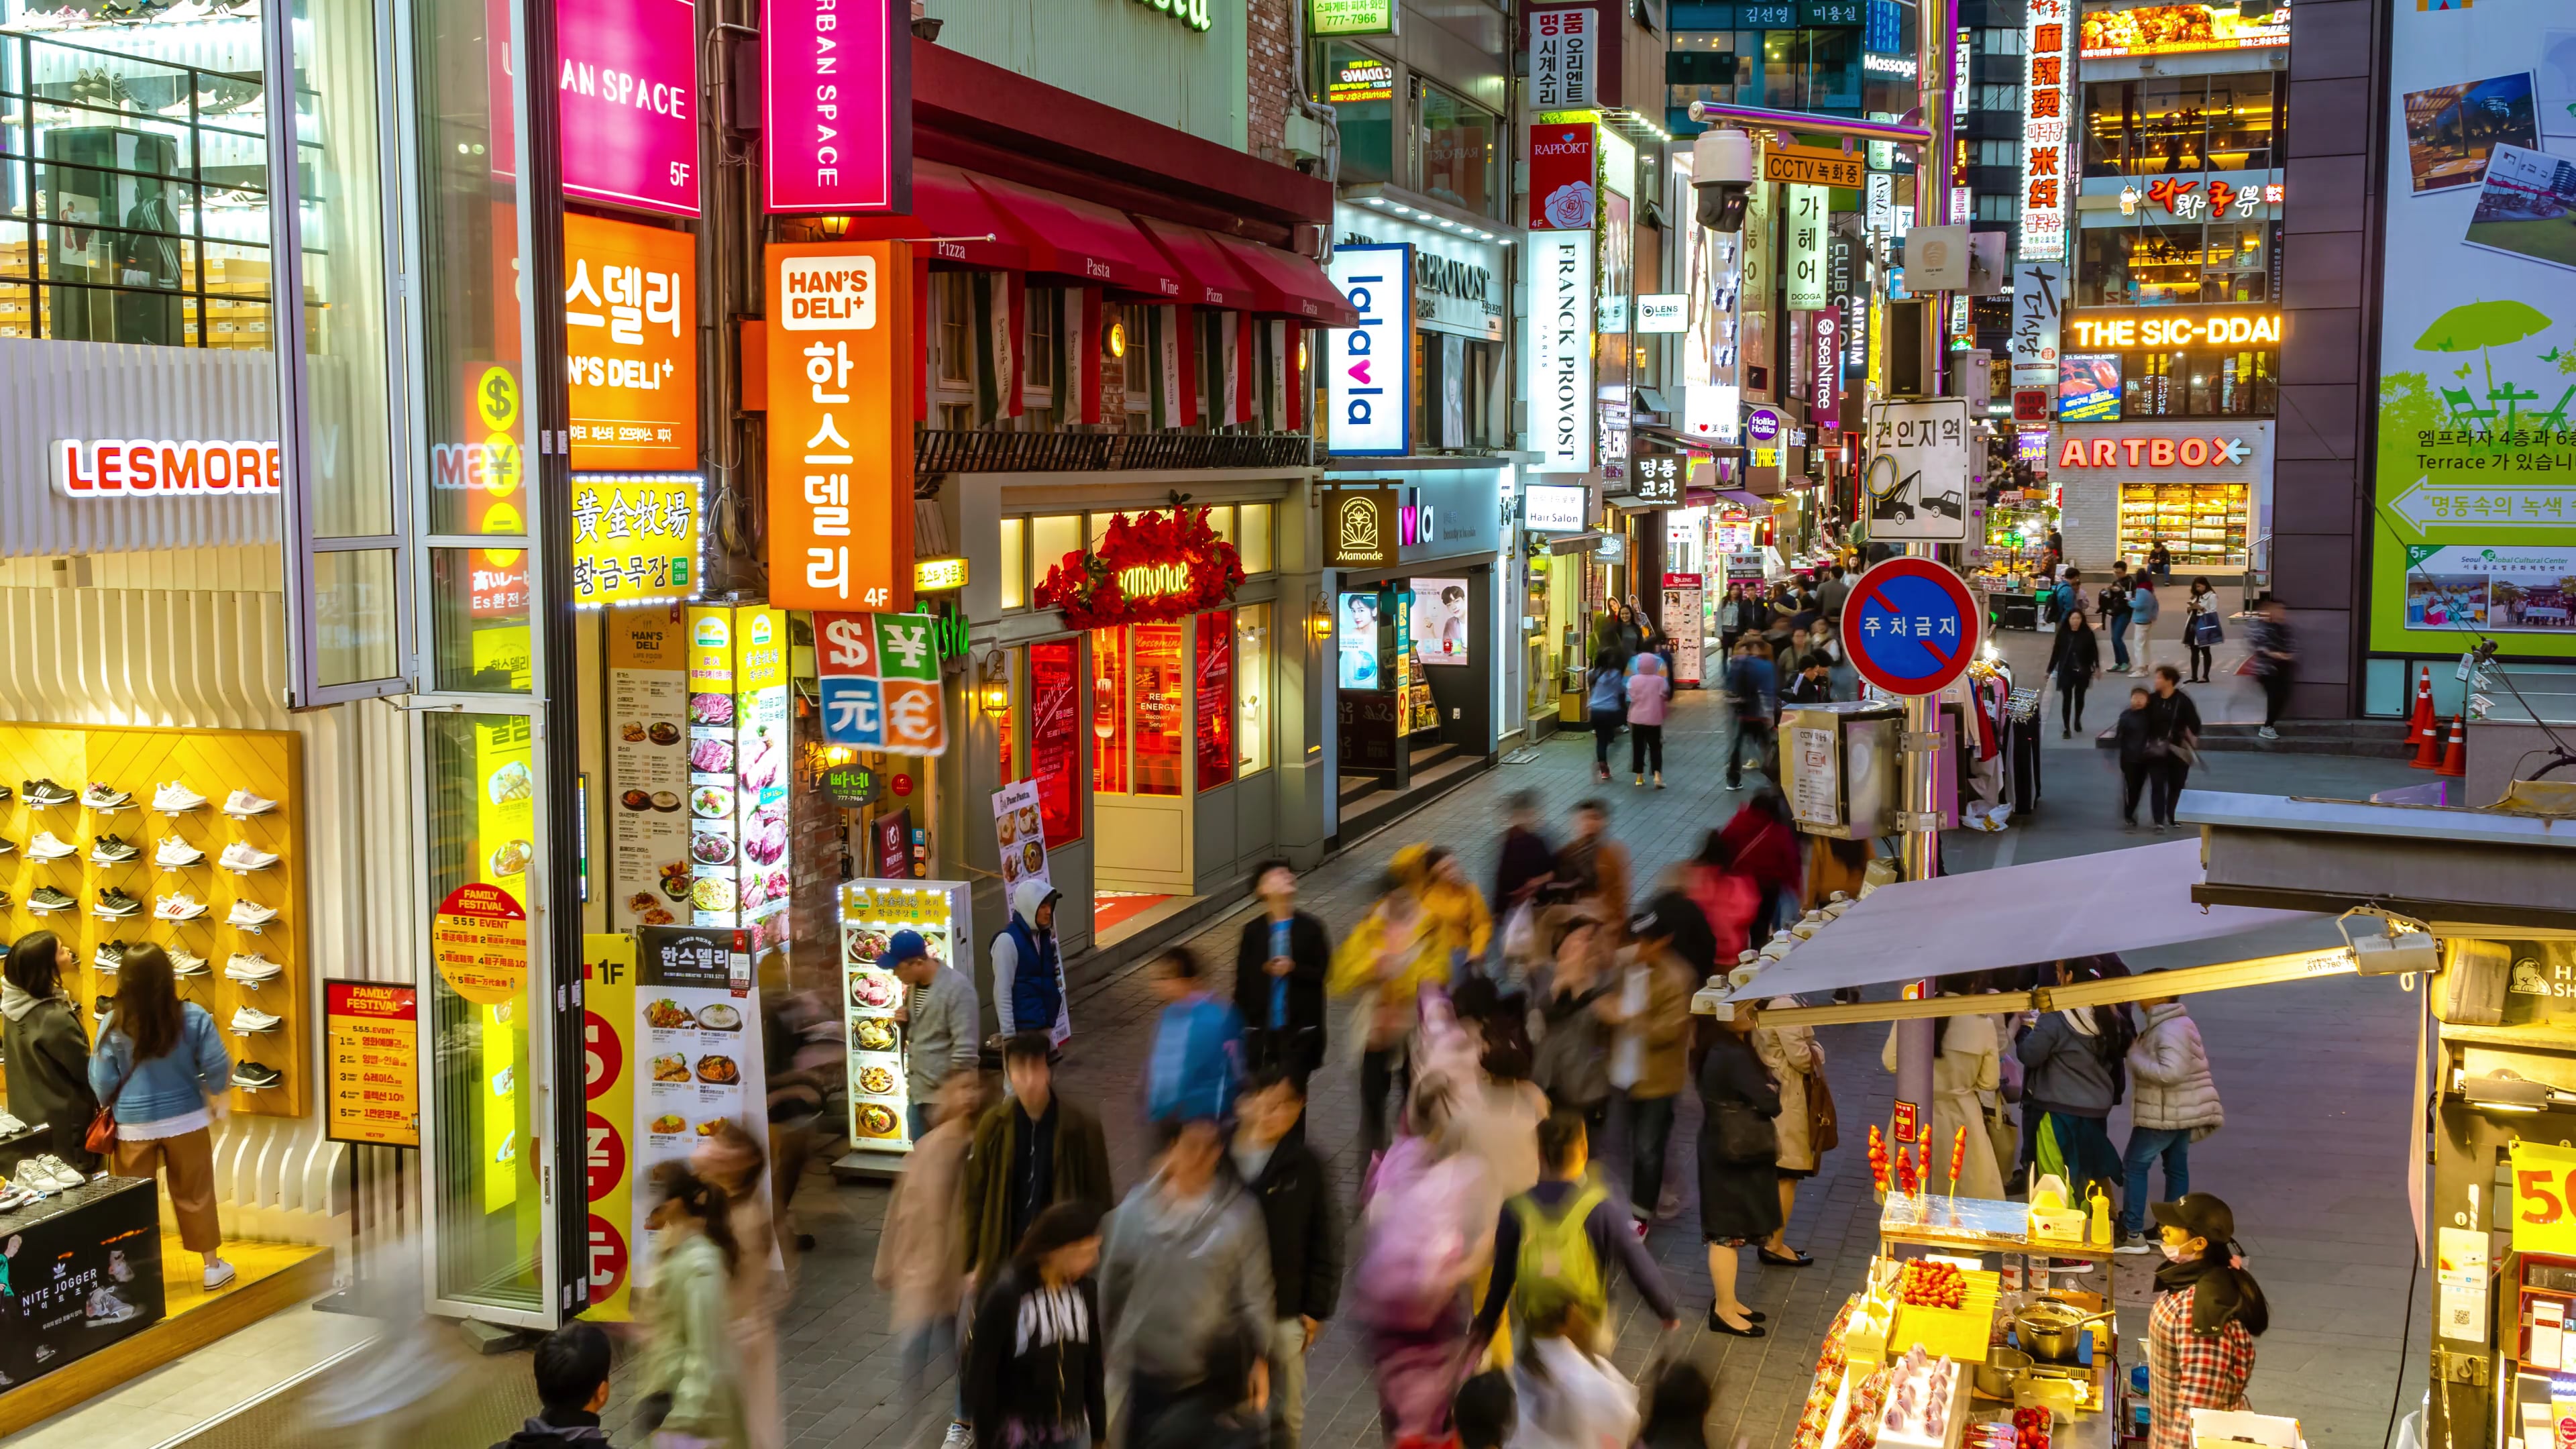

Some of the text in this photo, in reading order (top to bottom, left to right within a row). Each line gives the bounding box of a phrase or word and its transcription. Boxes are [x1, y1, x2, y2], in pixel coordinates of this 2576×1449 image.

[1326, 13, 1377, 27] 777-7966
[1539, 12, 1583, 36] 명품
[1746, 6, 1858, 23] 김선영 미용실
[1539, 40, 1557, 105] 시계수리
[1566, 38, 1584, 103] 오리엔트
[1864, 54, 1917, 77] Massage
[2031, 23, 2063, 119] 麻辣烫
[602, 69, 686, 119] SPACE
[816, 85, 838, 187] SPACE
[2027, 122, 2063, 142] 마라탕
[1535, 142, 1589, 156] RAPPORT
[669, 161, 690, 187] 5F
[1770, 157, 1858, 183] CCTV 녹화중
[2029, 146, 2059, 209] 米线
[1953, 189, 1966, 225] 플로레
[1532, 219, 1544, 228] 4F
[2025, 213, 2061, 233] 쌀국수
[1797, 184, 1819, 284] 가헤어
[937, 239, 967, 260] Pizza
[1086, 257, 1110, 279] Pasta
[1421, 252, 1491, 301] PROVOST
[1834, 244, 1849, 292] CLUB
[789, 270, 868, 294] HAN'S
[1160, 277, 1179, 297] Wine
[566, 258, 681, 345] 스델리
[1205, 286, 1224, 304] Pizza
[1302, 298, 1318, 316] Pasta
[1416, 298, 1436, 319] PARIS
[1850, 296, 1865, 366] ARITAUM
[2074, 319, 2135, 347] THE
[1558, 243, 1576, 461] FRANCK PROVOST
[1817, 337, 1835, 409] seaNtree
[1751, 425, 1776, 435] Holika
[1752, 416, 1776, 426] Holika
[657, 428, 672, 442] 피자
[1876, 418, 1962, 447] 견인지역
[2418, 429, 2493, 448] 엠프라자
[2499, 429, 2551, 447] 4층과
[65, 443, 280, 492] LESMORE
[804, 340, 855, 600] 한스델리
[1640, 458, 1677, 478] 명동
[2417, 453, 2576, 472] Terrace 가 있습니
[1640, 481, 1677, 498] 교자
[2521, 496, 2563, 518] 녹색
[1529, 512, 1578, 523] Hair Salon
[1336, 551, 1383, 561] Mamonde
[2410, 546, 2428, 559] 5F
[2461, 556, 2481, 565] Seoul
[2513, 555, 2543, 564] Cultural
[574, 555, 669, 596] 황금목장
[918, 564, 965, 586] 파스타 전문점
[864, 587, 888, 606] 4F
[631, 631, 663, 641] HAN'S
[1864, 616, 1957, 637] 주차금지
[636, 641, 659, 650] DELI
[826, 619, 868, 668] $
[1148, 692, 1168, 701] RED
[827, 690, 879, 733] 元
[1140, 702, 1176, 712] ENERGY
[1145, 713, 1171, 722] Recovery
[830, 771, 869, 789] 빠네
[458, 898, 504, 912] FESTIVAL
[464, 889, 498, 901] FAMILY
[479, 918, 510, 929] EVENT
[480, 936, 486, 944] 2
[439, 953, 445, 961] 3
[661, 946, 729, 969] 한스델리
[598, 959, 625, 985] 1F
[353, 987, 393, 1000] FAMILY
[347, 998, 400, 1012] FESTIVAL
[372, 1027, 395, 1035] EVENT
[339, 1055, 346, 1063] 2
[339, 1073, 347, 1081] 3
[339, 1090, 347, 1099] 4
[340, 1108, 347, 1117] 5
[22, 1268, 98, 1307] NITE JOGGER
